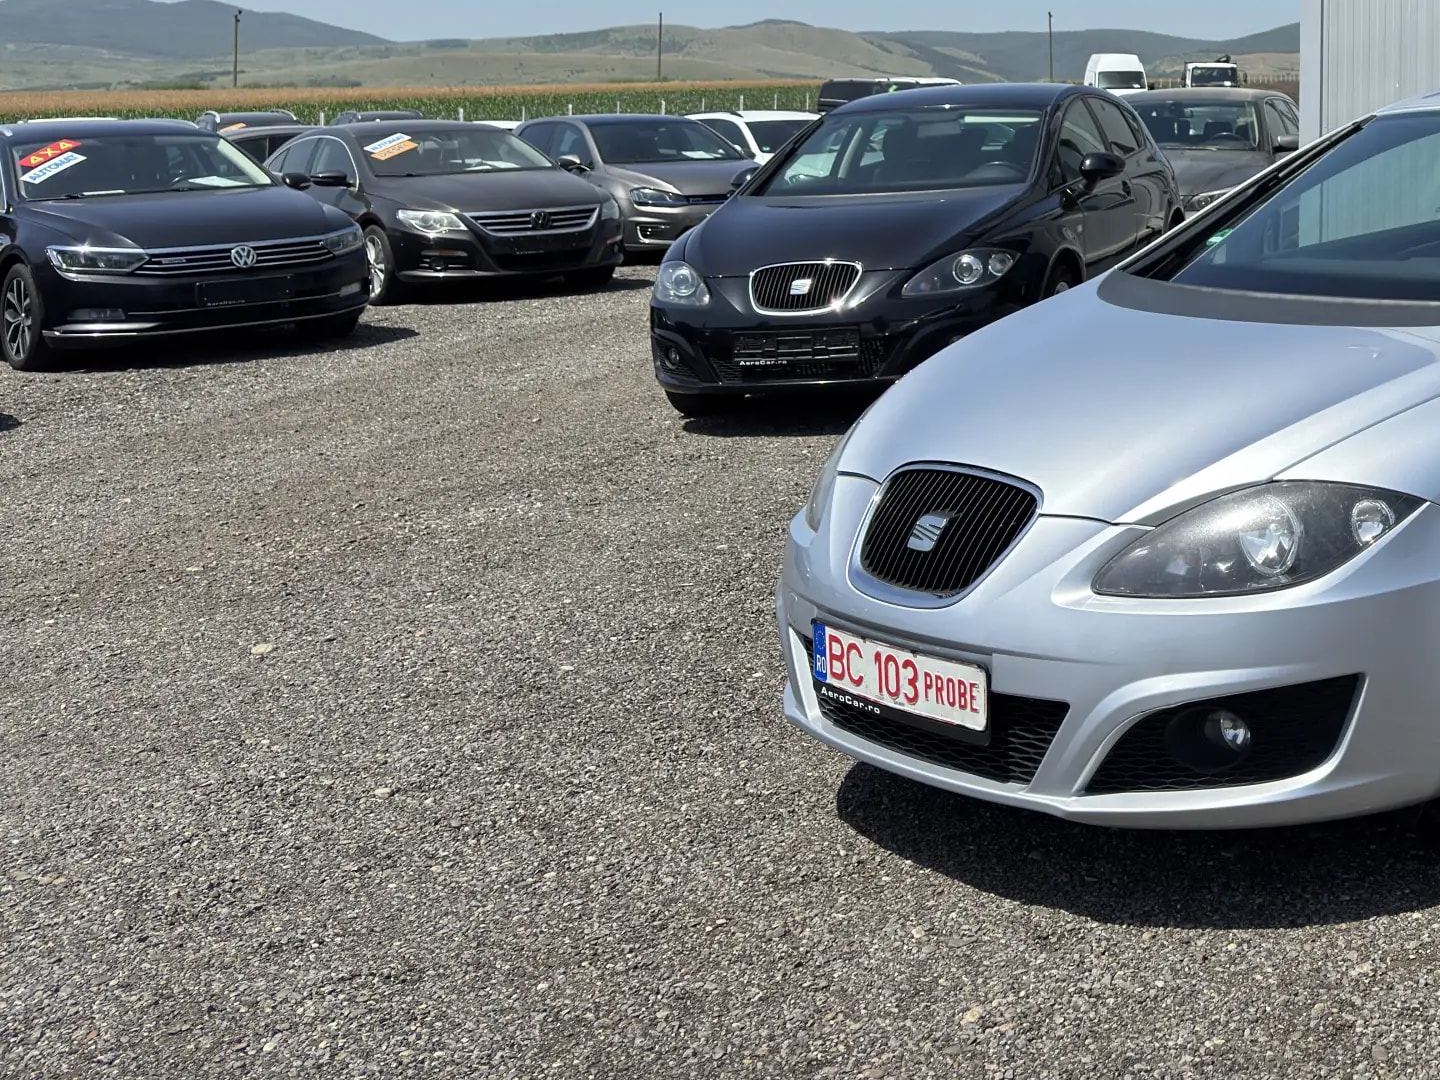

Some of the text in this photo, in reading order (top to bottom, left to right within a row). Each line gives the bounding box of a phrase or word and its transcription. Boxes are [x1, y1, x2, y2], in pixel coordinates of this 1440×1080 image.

[29, 154, 78, 181] AUTOMAT
[816, 654, 827, 675] RO
[828, 634, 980, 714] BC 103 PROBE
[821, 686, 881, 715] AeroCar.ro
